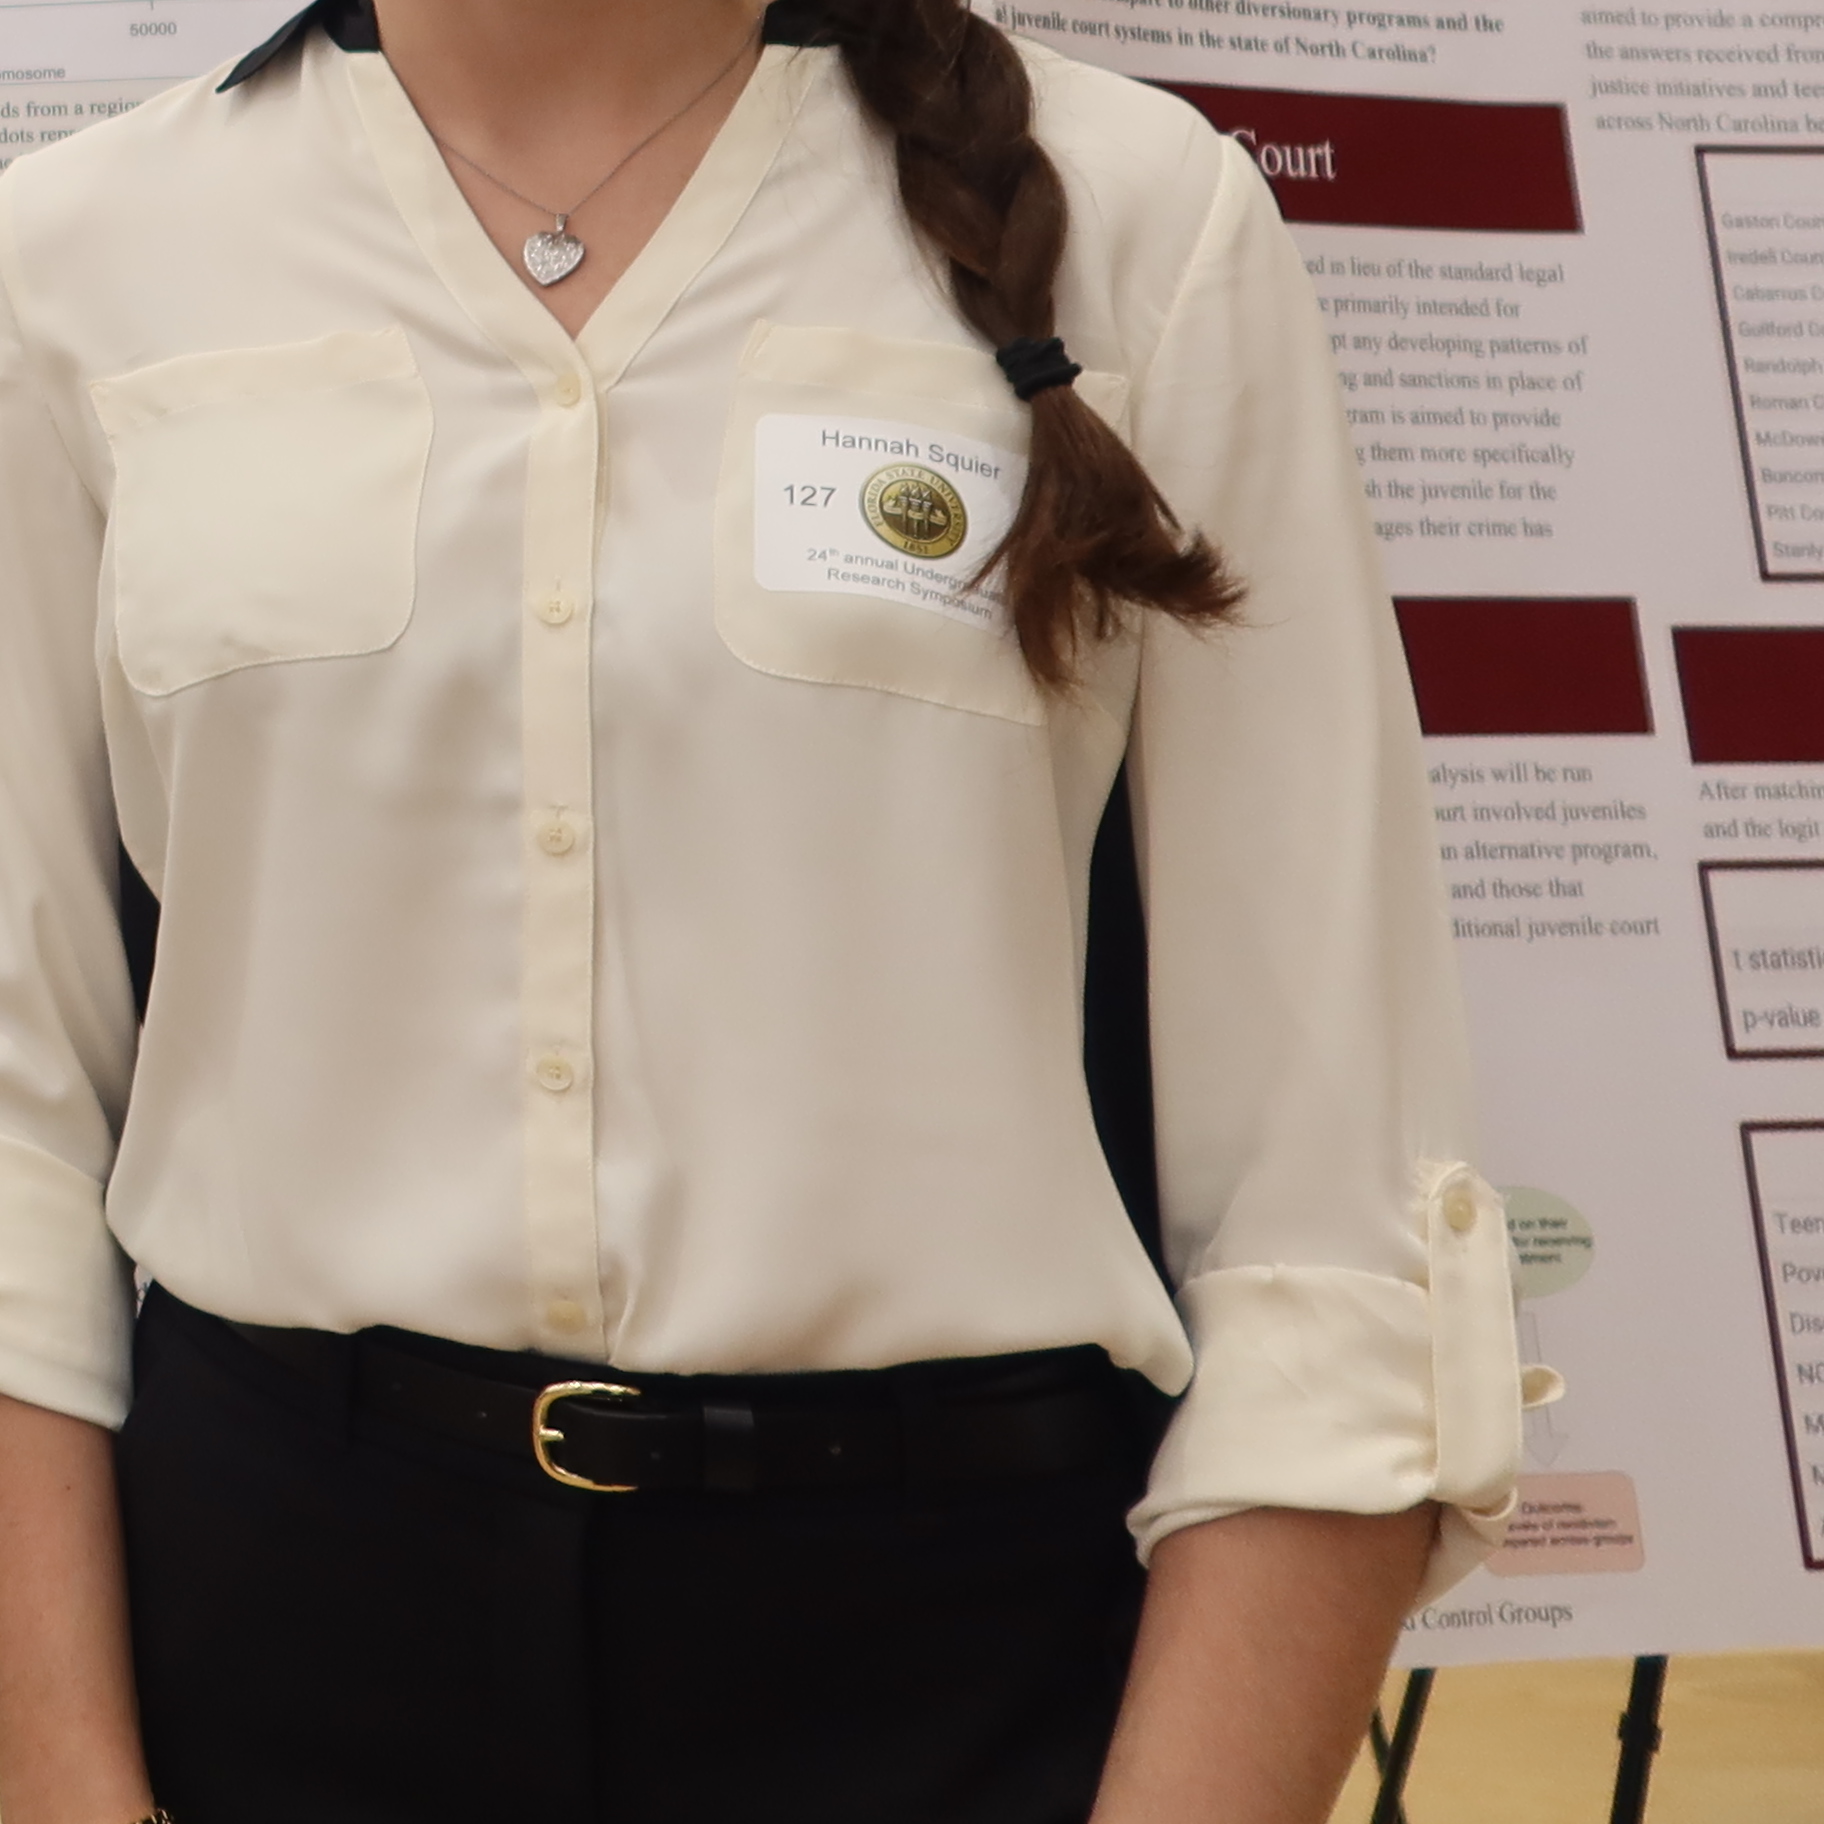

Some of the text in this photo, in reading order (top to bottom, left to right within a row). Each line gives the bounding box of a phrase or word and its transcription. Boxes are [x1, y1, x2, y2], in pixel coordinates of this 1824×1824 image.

[128, 22, 178, 39] 50000
[821, 429, 1002, 480] Hannah Squier
[783, 484, 838, 509] 127
[844, 552, 899, 572] annual
[827, 567, 993, 620] Research Symposium
